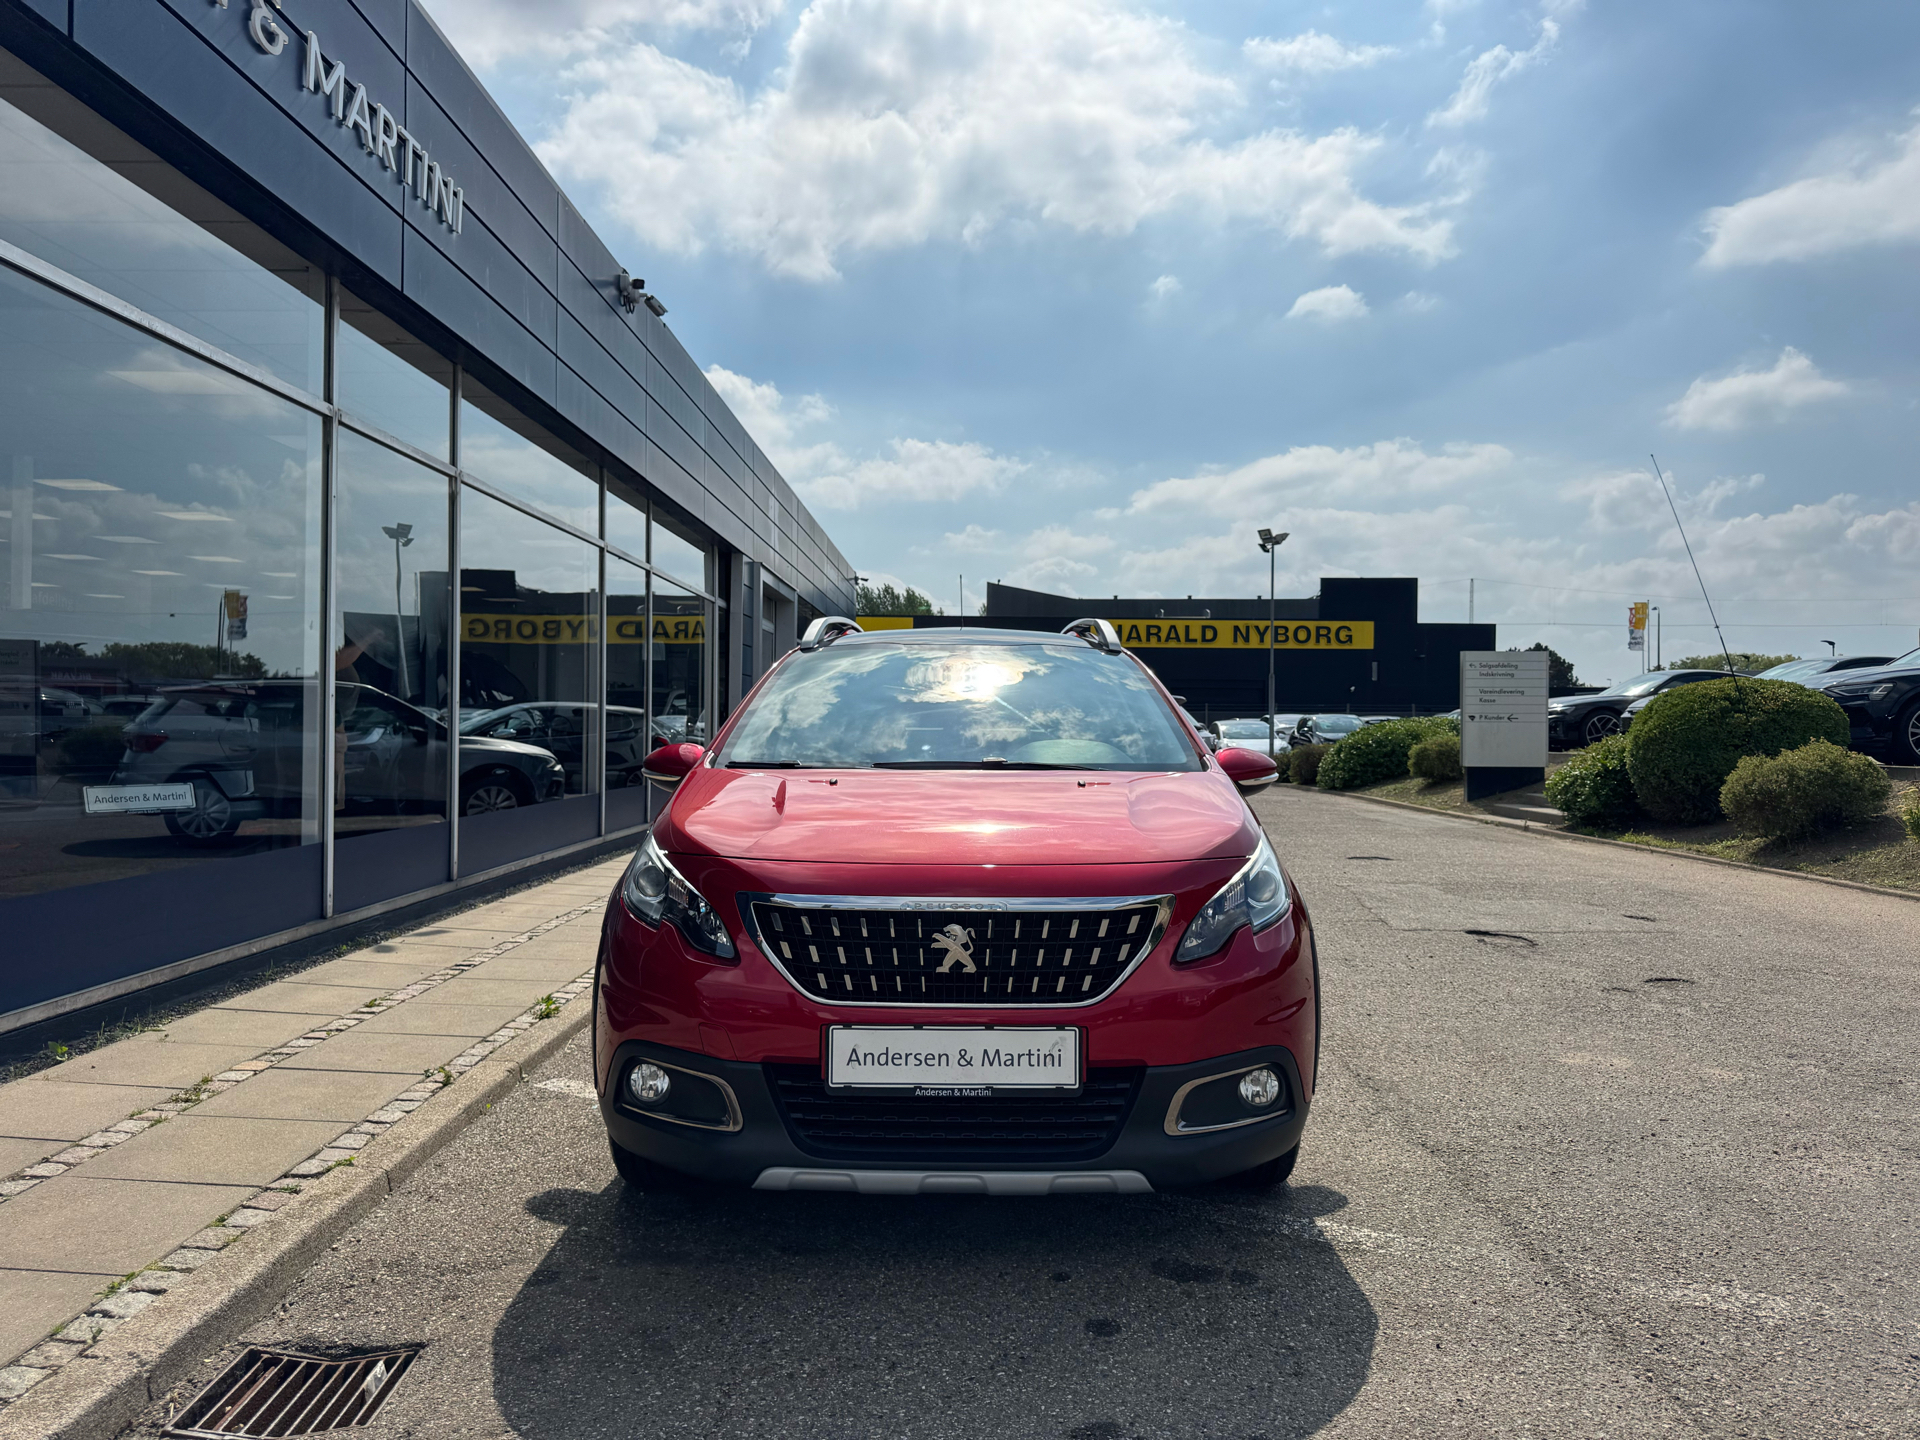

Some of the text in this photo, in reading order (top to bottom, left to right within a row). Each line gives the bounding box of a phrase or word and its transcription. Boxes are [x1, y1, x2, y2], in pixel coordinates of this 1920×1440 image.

[302, 30, 463, 234] MARTINI
[1232, 625, 1353, 644] NYBORG
[94, 792, 187, 804] Andersen & Martini
[847, 1047, 1062, 1068] Andersen & Martini
[915, 1088, 952, 1096] Andersen
[963, 1088, 992, 1096] Martini
